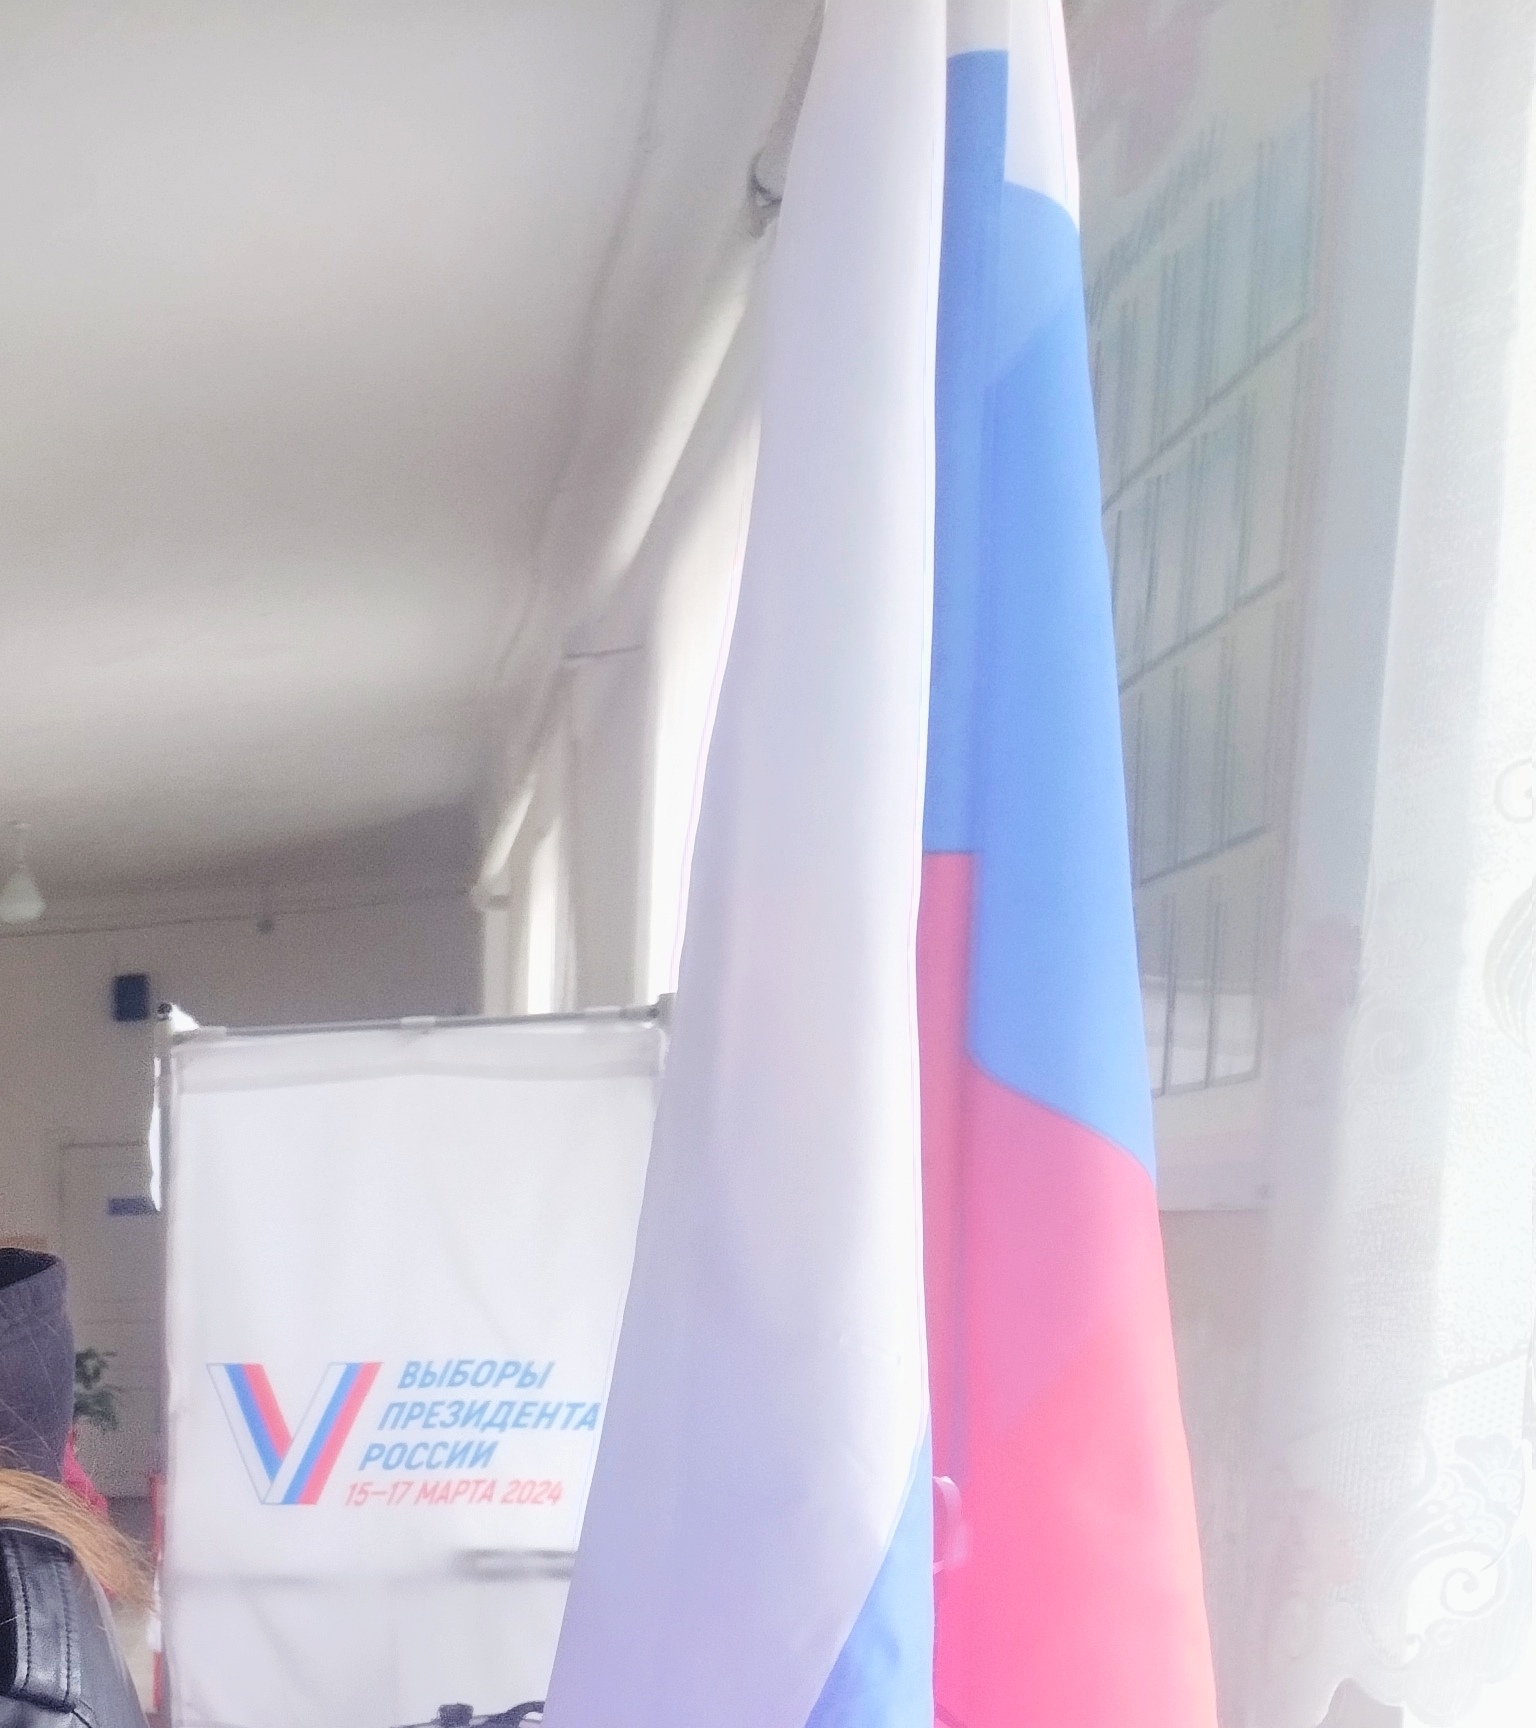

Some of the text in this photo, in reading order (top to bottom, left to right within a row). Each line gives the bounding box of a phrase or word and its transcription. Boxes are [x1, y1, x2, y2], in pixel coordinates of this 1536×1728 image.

[396, 1360, 556, 1390] ВЫБОРЫ
[377, 1401, 601, 1433] ПРЕЗИДЕНТА
[358, 1442, 499, 1471] РОССИИ
[412, 1480, 497, 1507] МАРТА
[500, 1479, 567, 1507] 2024
